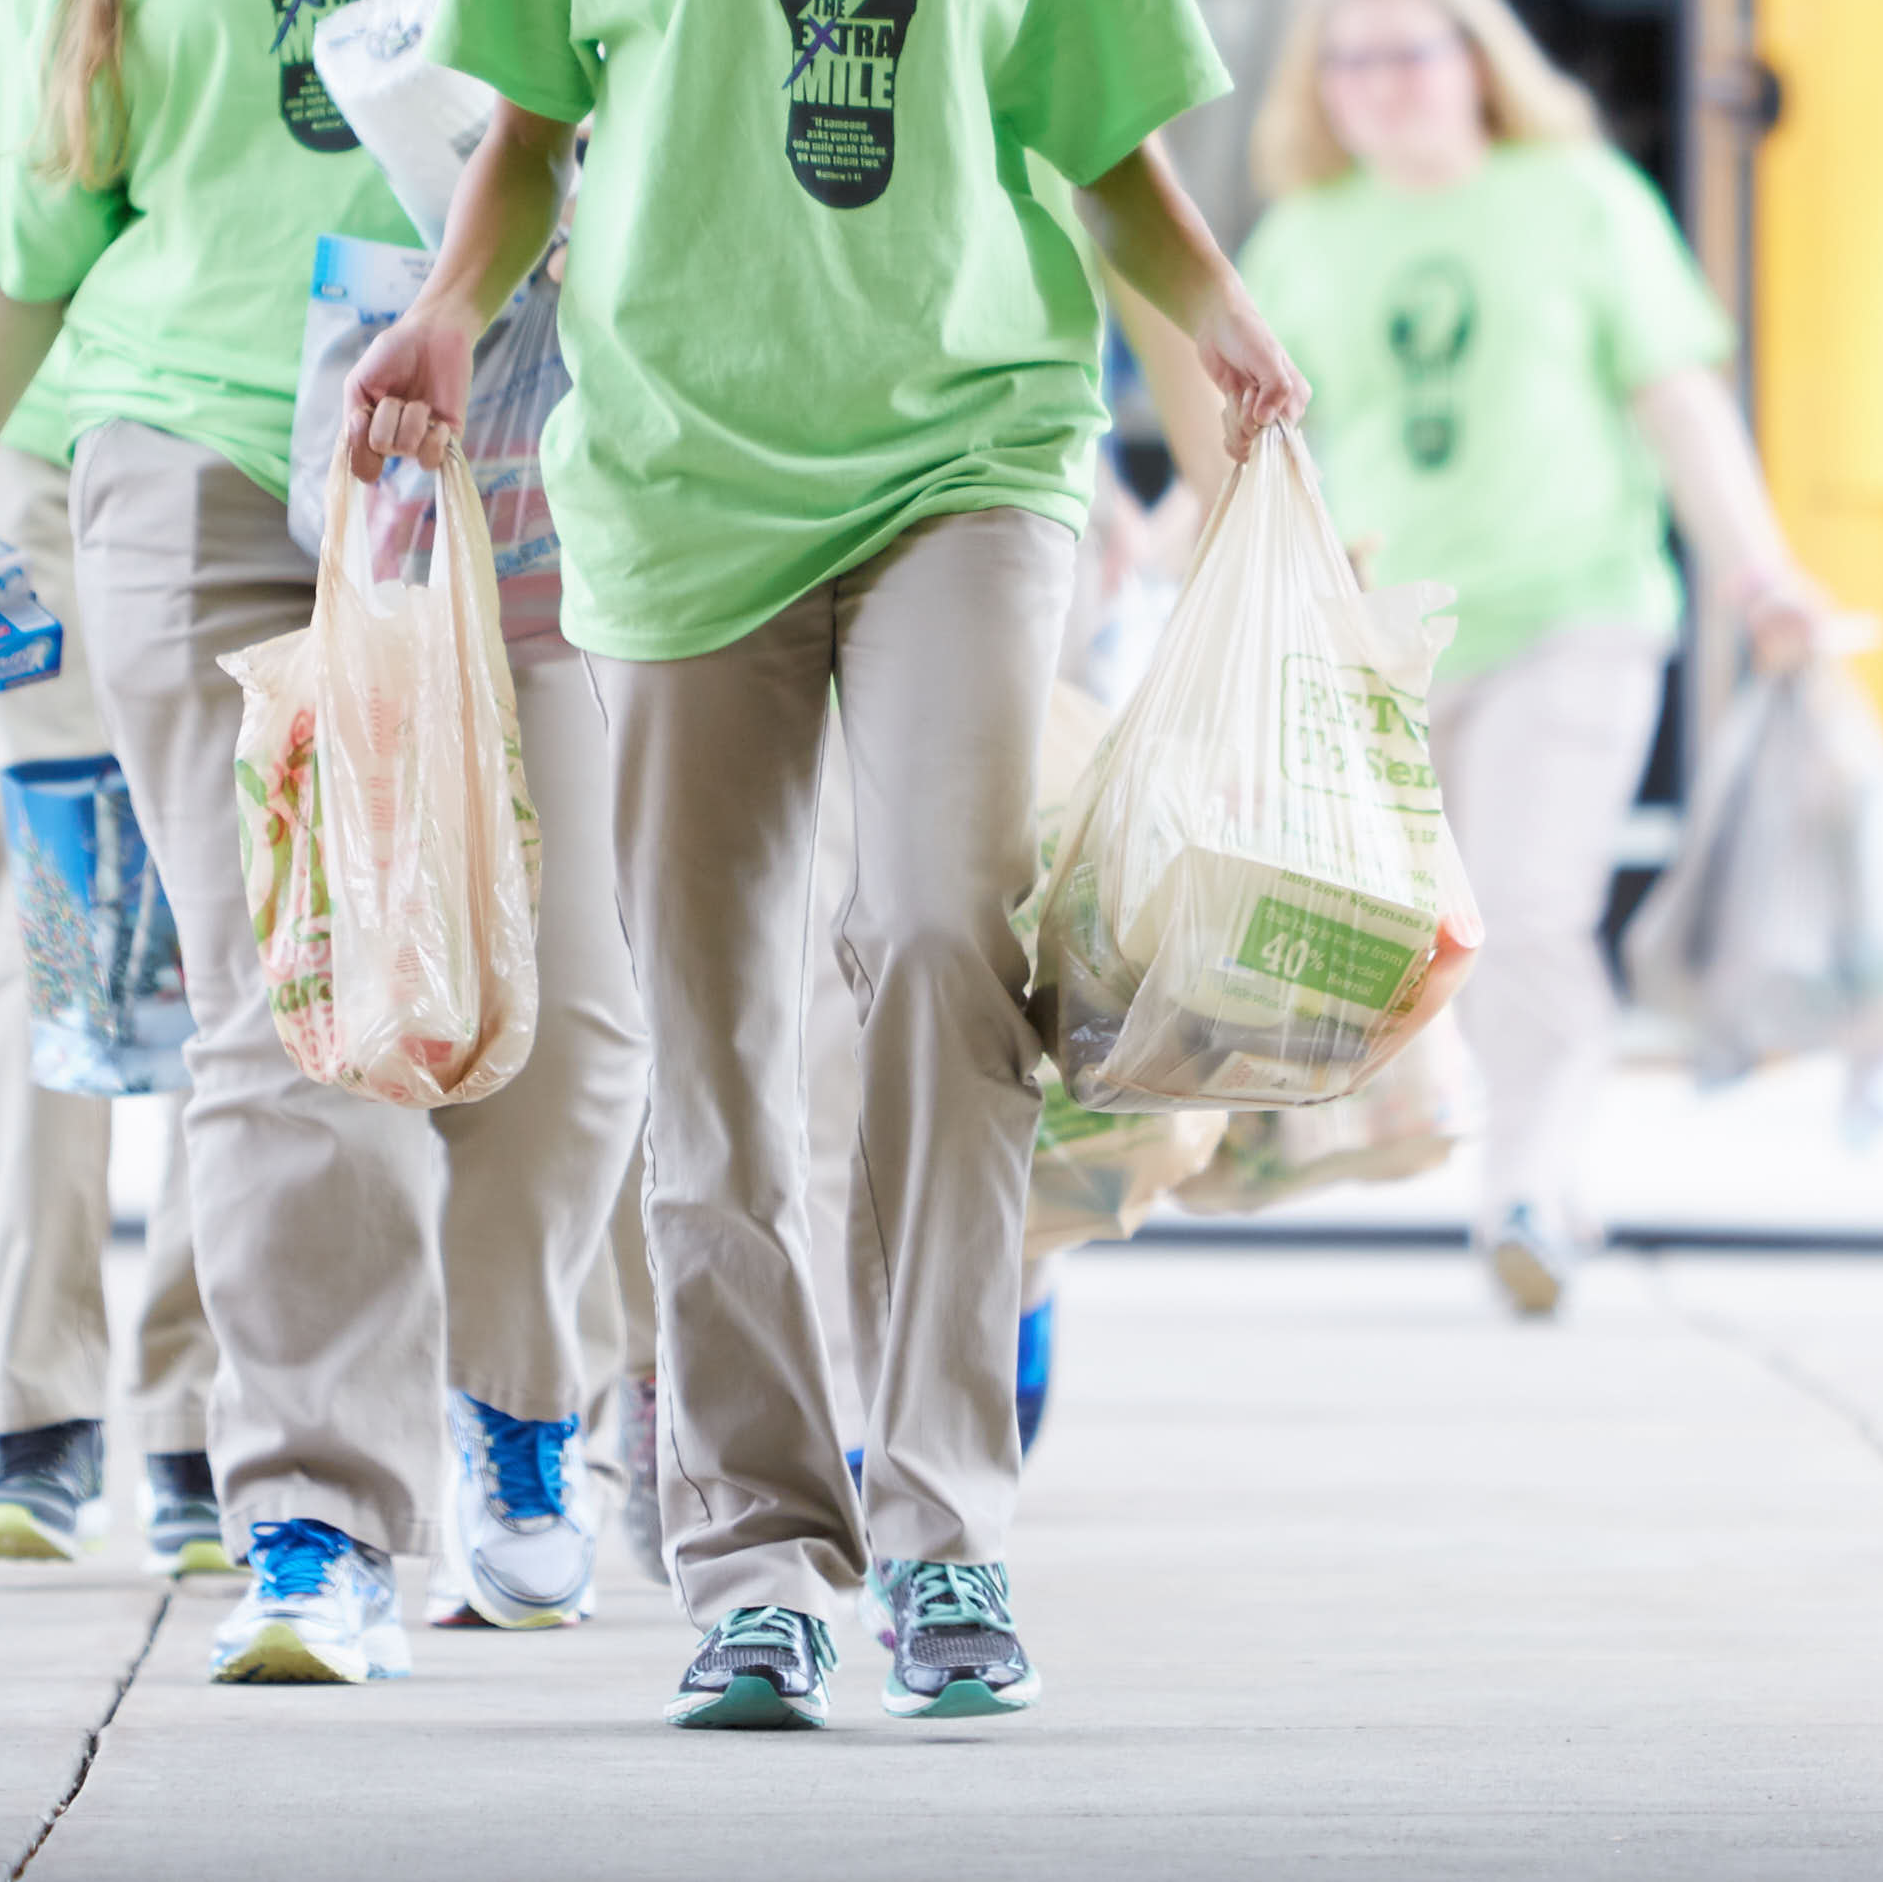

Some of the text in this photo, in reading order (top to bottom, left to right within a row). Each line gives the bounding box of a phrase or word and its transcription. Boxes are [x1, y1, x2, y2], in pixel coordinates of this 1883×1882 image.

[792, 49, 895, 109] MILE
[824, 118, 867, 131] someone
[806, 129, 874, 144] asks you to go
[792, 139, 810, 150] one
[812, 141, 834, 152] mile
[836, 144, 857, 155] with
[810, 154, 831, 165] with
[833, 155, 858, 167] them
[1261, 931, 1327, 980] 40%
